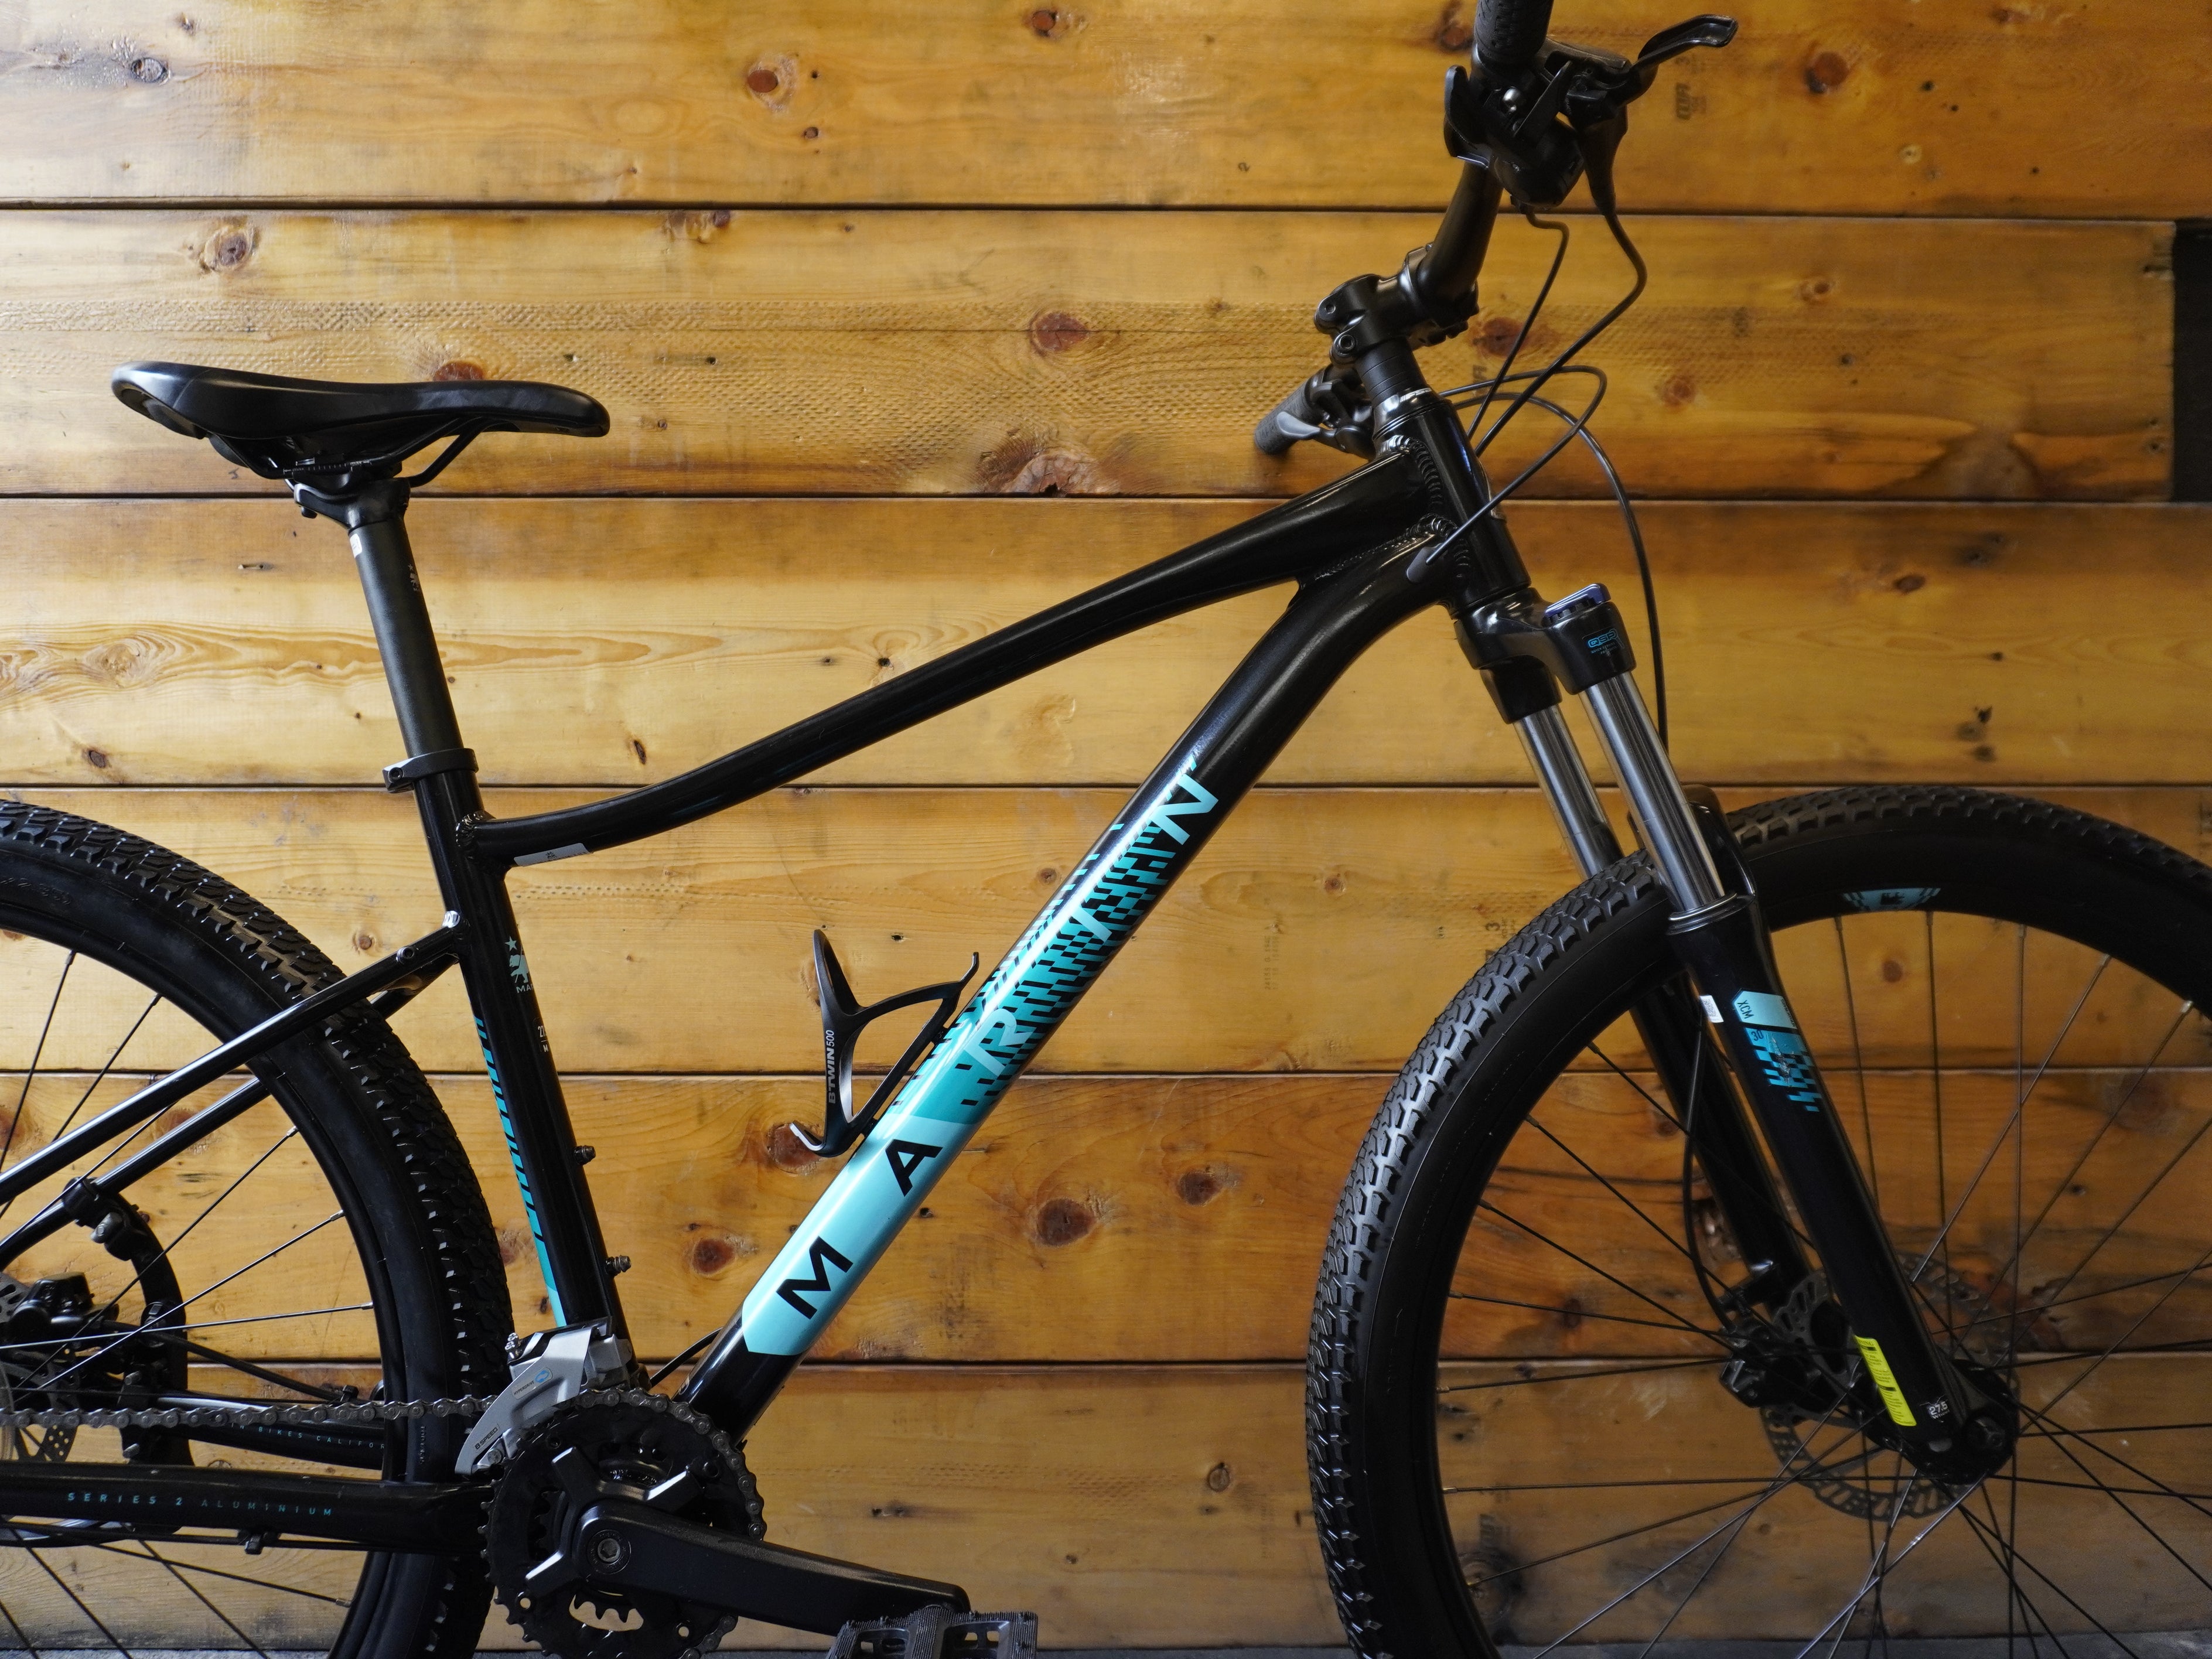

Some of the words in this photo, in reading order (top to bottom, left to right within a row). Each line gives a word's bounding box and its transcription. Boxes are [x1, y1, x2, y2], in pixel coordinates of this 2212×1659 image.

[1737, 999, 1754, 1019] XCM
[825, 1030, 835, 1047] 500
[1750, 1029, 1764, 1042] 30
[776, 773, 1219, 1320] MARIN
[1929, 1401, 1948, 1416] 27.5
[258, 1426, 303, 1439] BIKES
[480, 1426, 499, 1445] SPEED
[67, 1491, 157, 1506] SERIES
[175, 1496, 184, 1507] 2
[200, 1498, 333, 1517] ALUMINIUM
